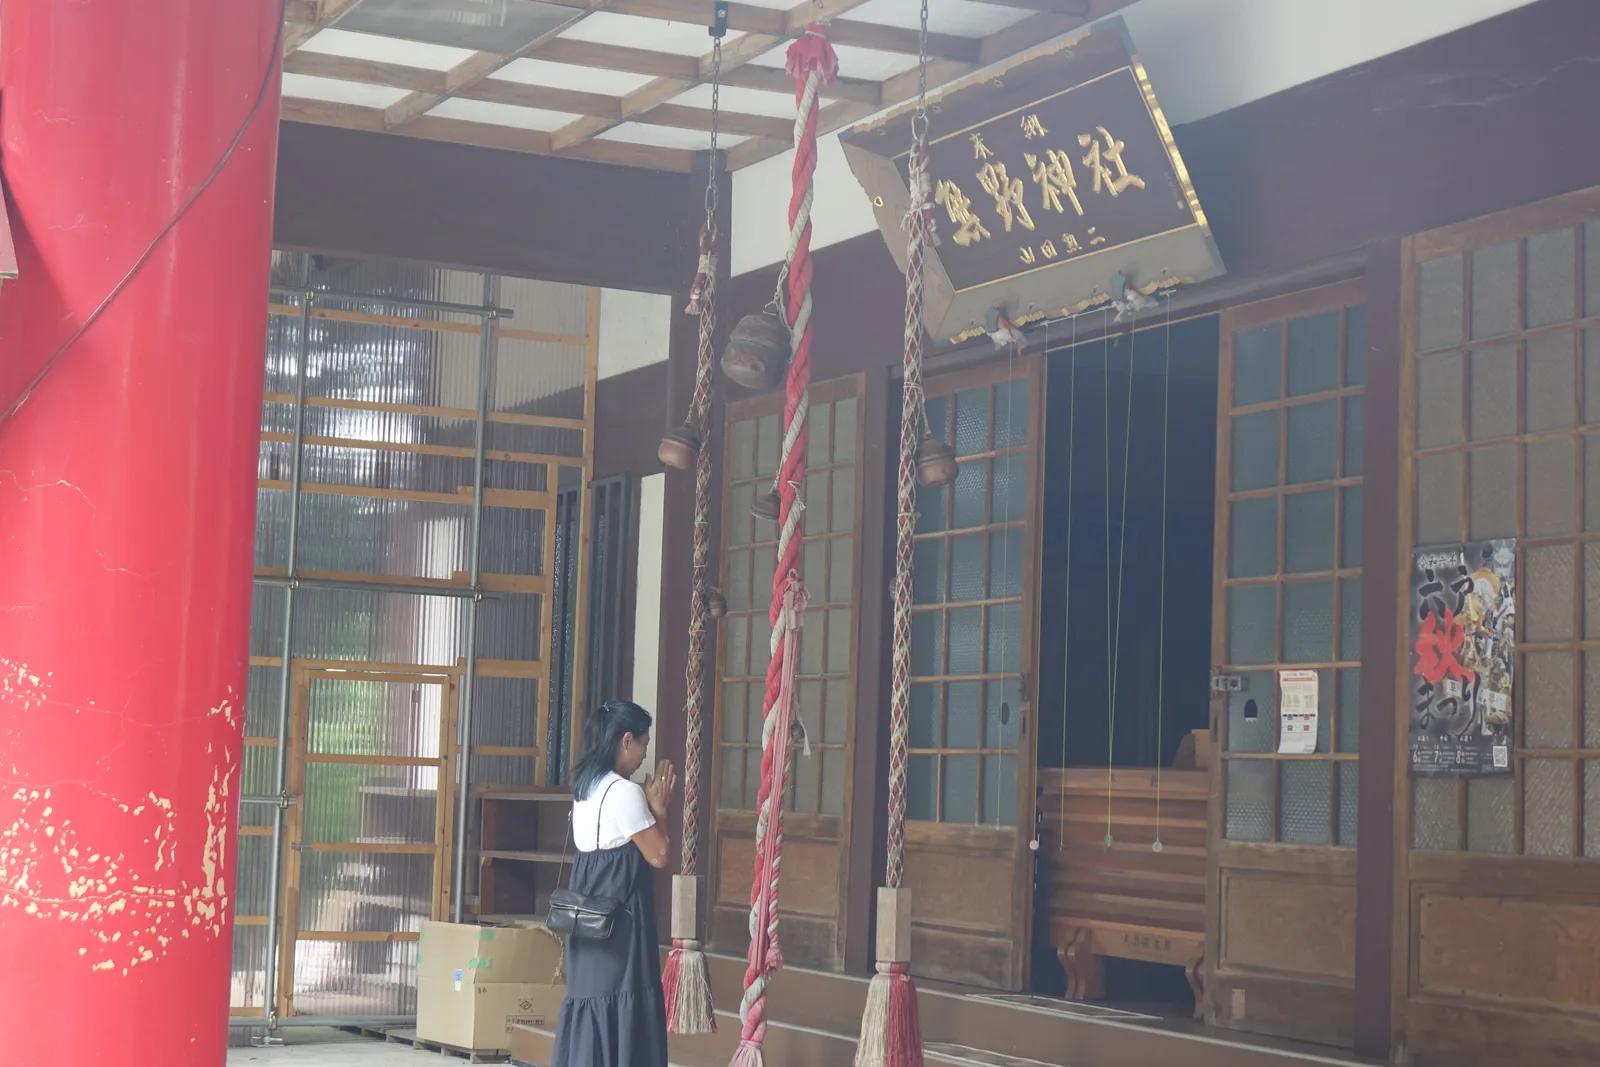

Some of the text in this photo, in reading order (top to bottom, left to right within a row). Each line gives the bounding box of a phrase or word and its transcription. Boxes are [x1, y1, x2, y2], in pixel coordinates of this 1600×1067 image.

[934, 125, 1146, 247] 熊野神社
[1419, 554, 1457, 568] 令和六年
[1414, 608, 1476, 683] 秋
[1415, 672, 1481, 739] まつり
